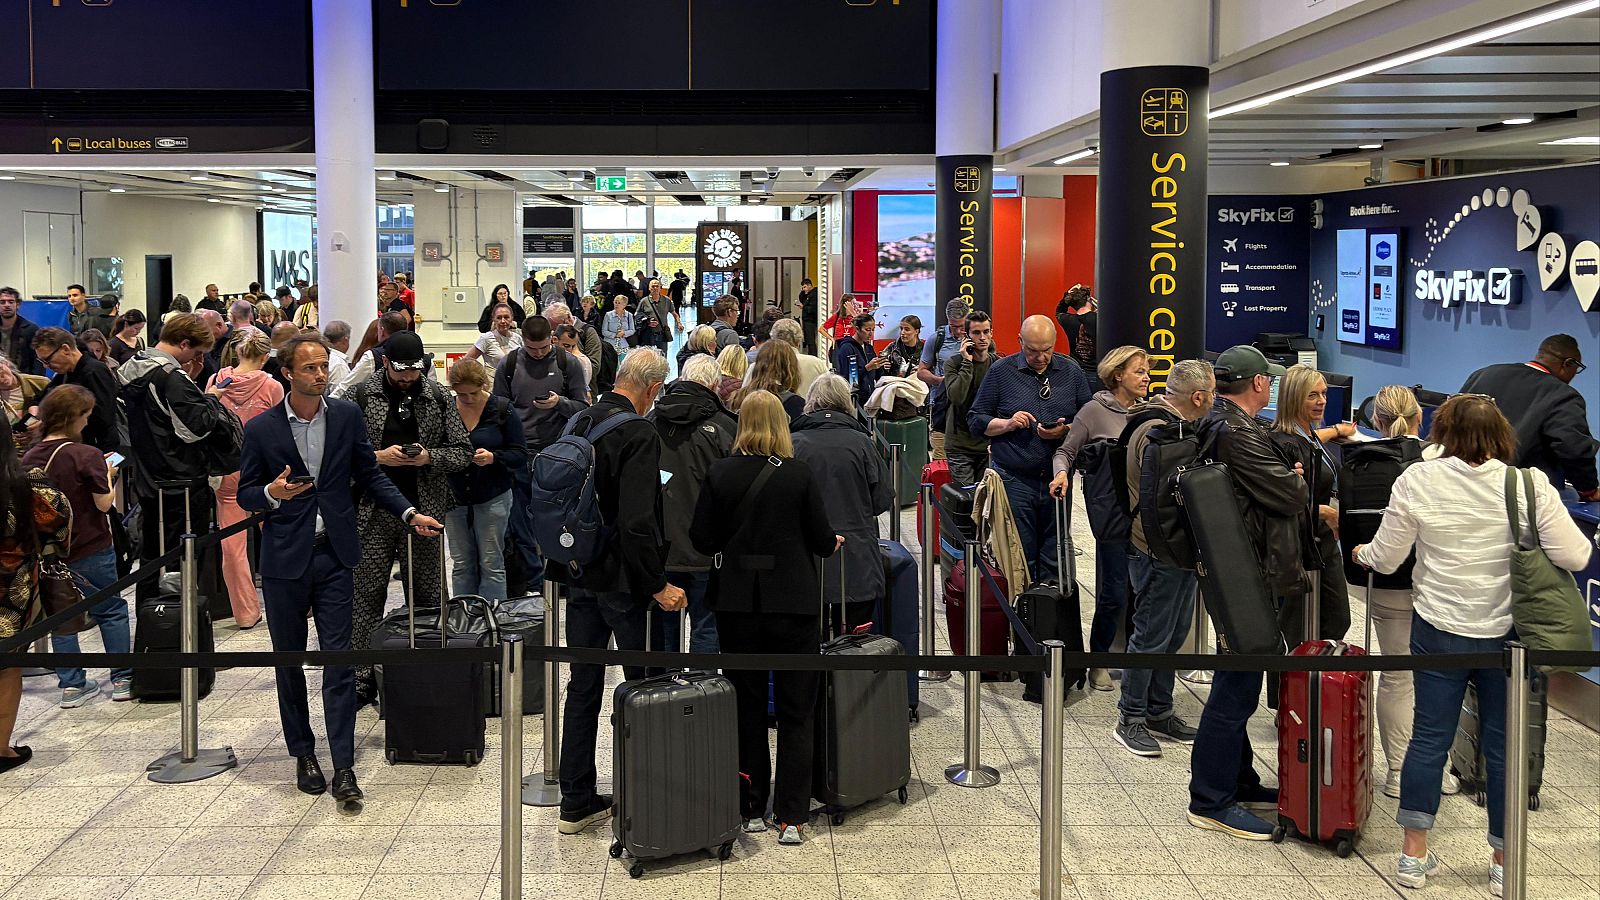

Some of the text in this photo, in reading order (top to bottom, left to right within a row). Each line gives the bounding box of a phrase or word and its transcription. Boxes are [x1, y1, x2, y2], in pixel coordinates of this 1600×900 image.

[85, 137, 152, 149] Local buses
[1218, 208, 1276, 226] SkyFix
[1350, 206, 1365, 217] Book
[1366, 205, 1380, 215] here
[1150, 152, 1187, 296] Service
[703, 228, 743, 254] BLACK SHEEP
[1245, 243, 1268, 251] Flights
[712, 251, 742, 268] COFFEE
[959, 200, 979, 313] Service ce
[270, 249, 311, 290] M&S
[1245, 263, 1297, 271] Accommodation
[1245, 284, 1276, 293] Transport
[1415, 269, 1486, 309] SkyFix
[1259, 305, 1288, 313] Property
